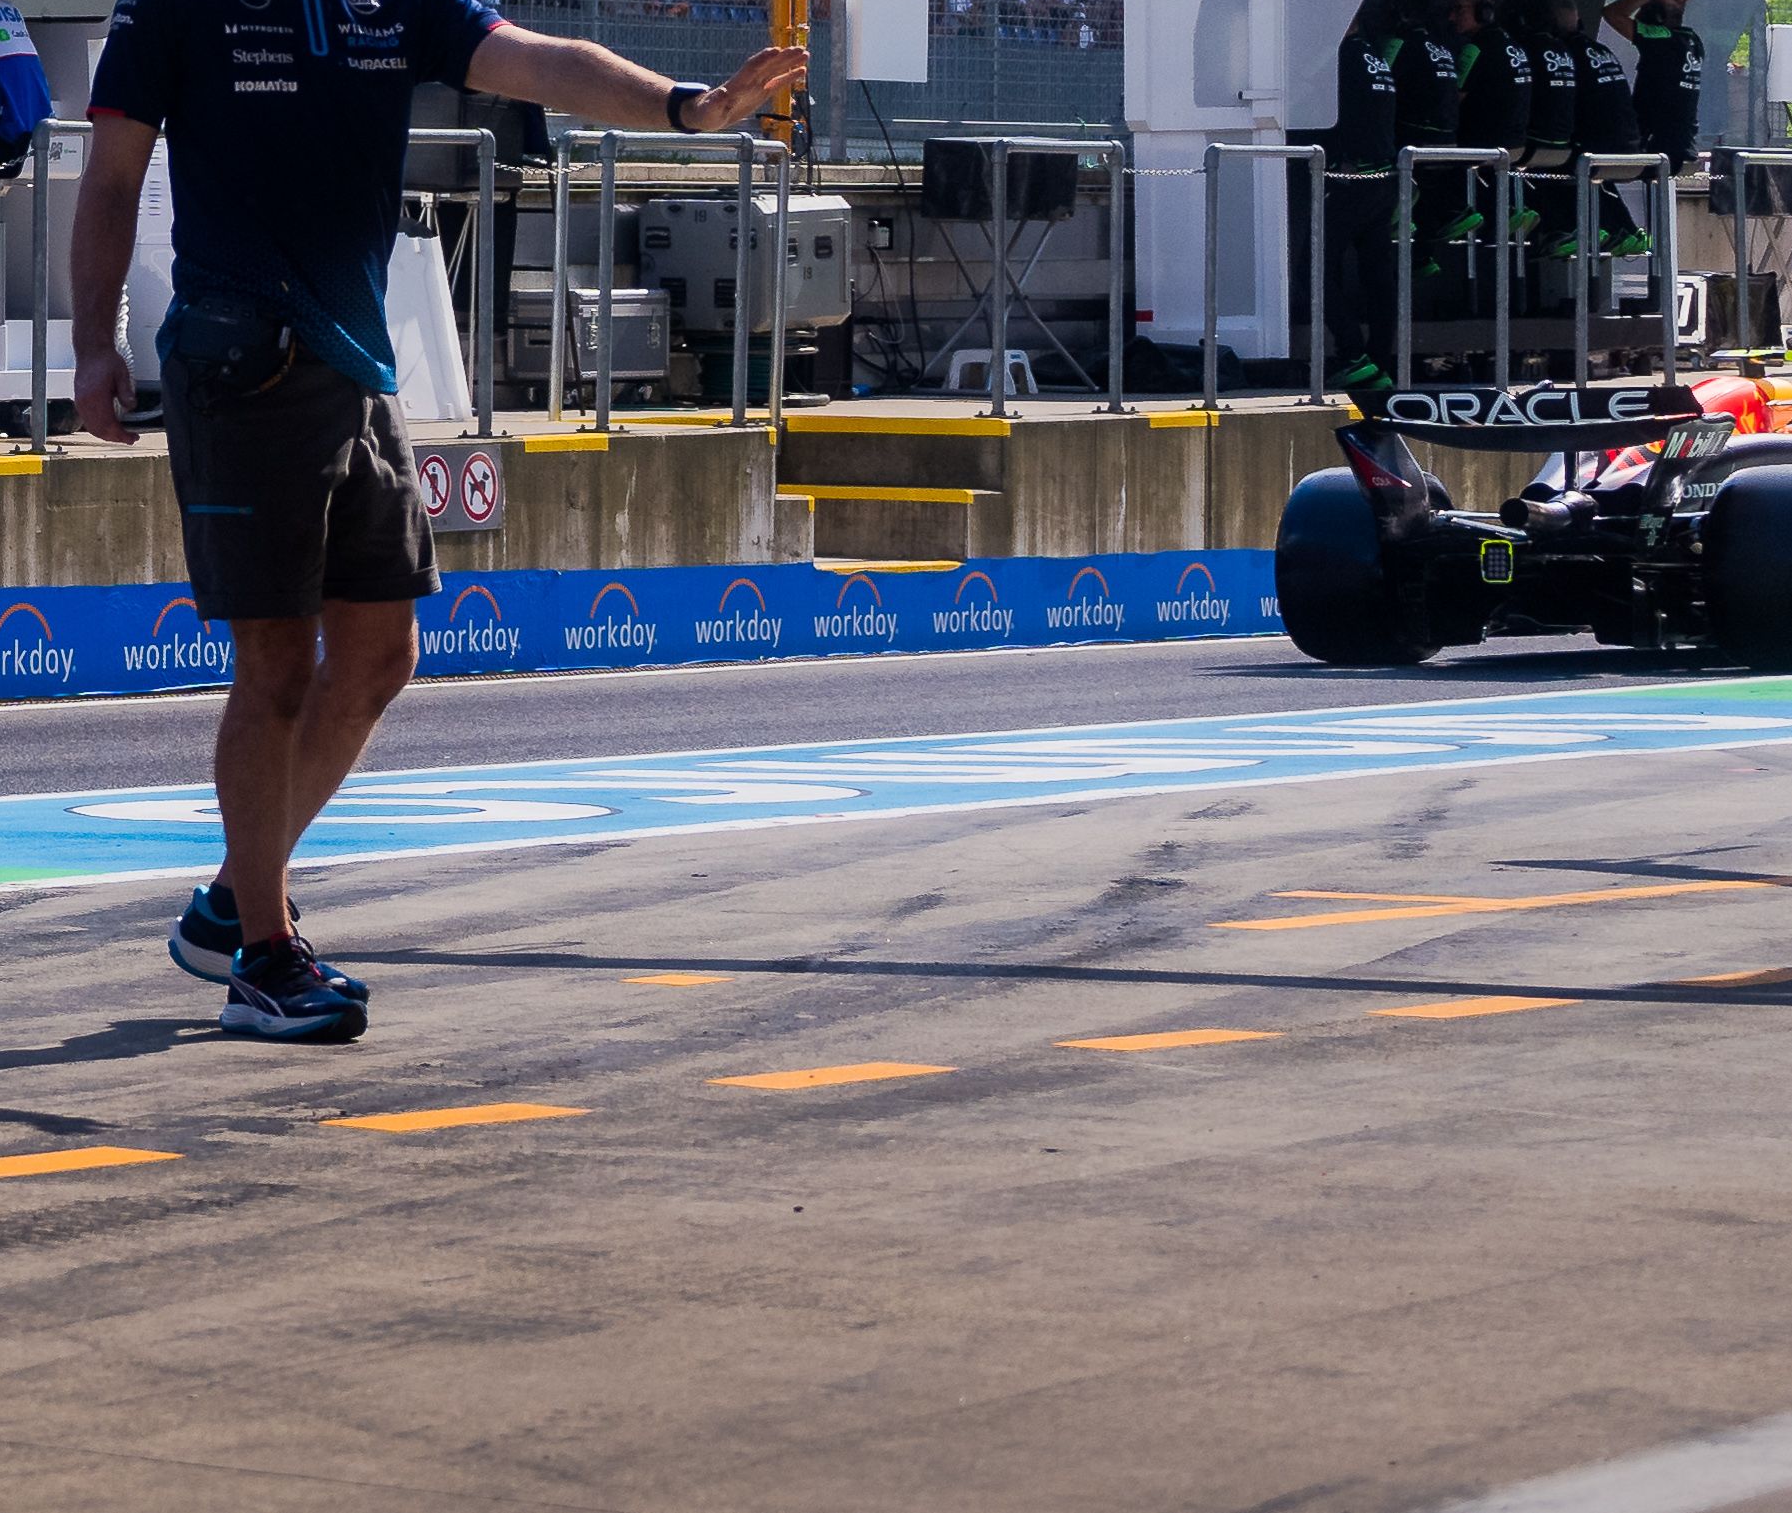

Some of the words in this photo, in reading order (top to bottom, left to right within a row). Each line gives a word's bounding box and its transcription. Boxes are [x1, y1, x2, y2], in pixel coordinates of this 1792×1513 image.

[338, 22, 405, 38] WILLIAMS
[232, 48, 295, 66] Stephens
[234, 78, 298, 93] KOMATSU
[1386, 390, 1650, 426] ORACLE
[696, 609, 781, 648] workday
[814, 605, 897, 644] workday
[933, 601, 1014, 640] workday
[1047, 597, 1124, 633] workday
[1157, 592, 1230, 628] workday
[423, 619, 519, 657] workday
[565, 614, 656, 654] workday
[124, 634, 232, 676] workday
